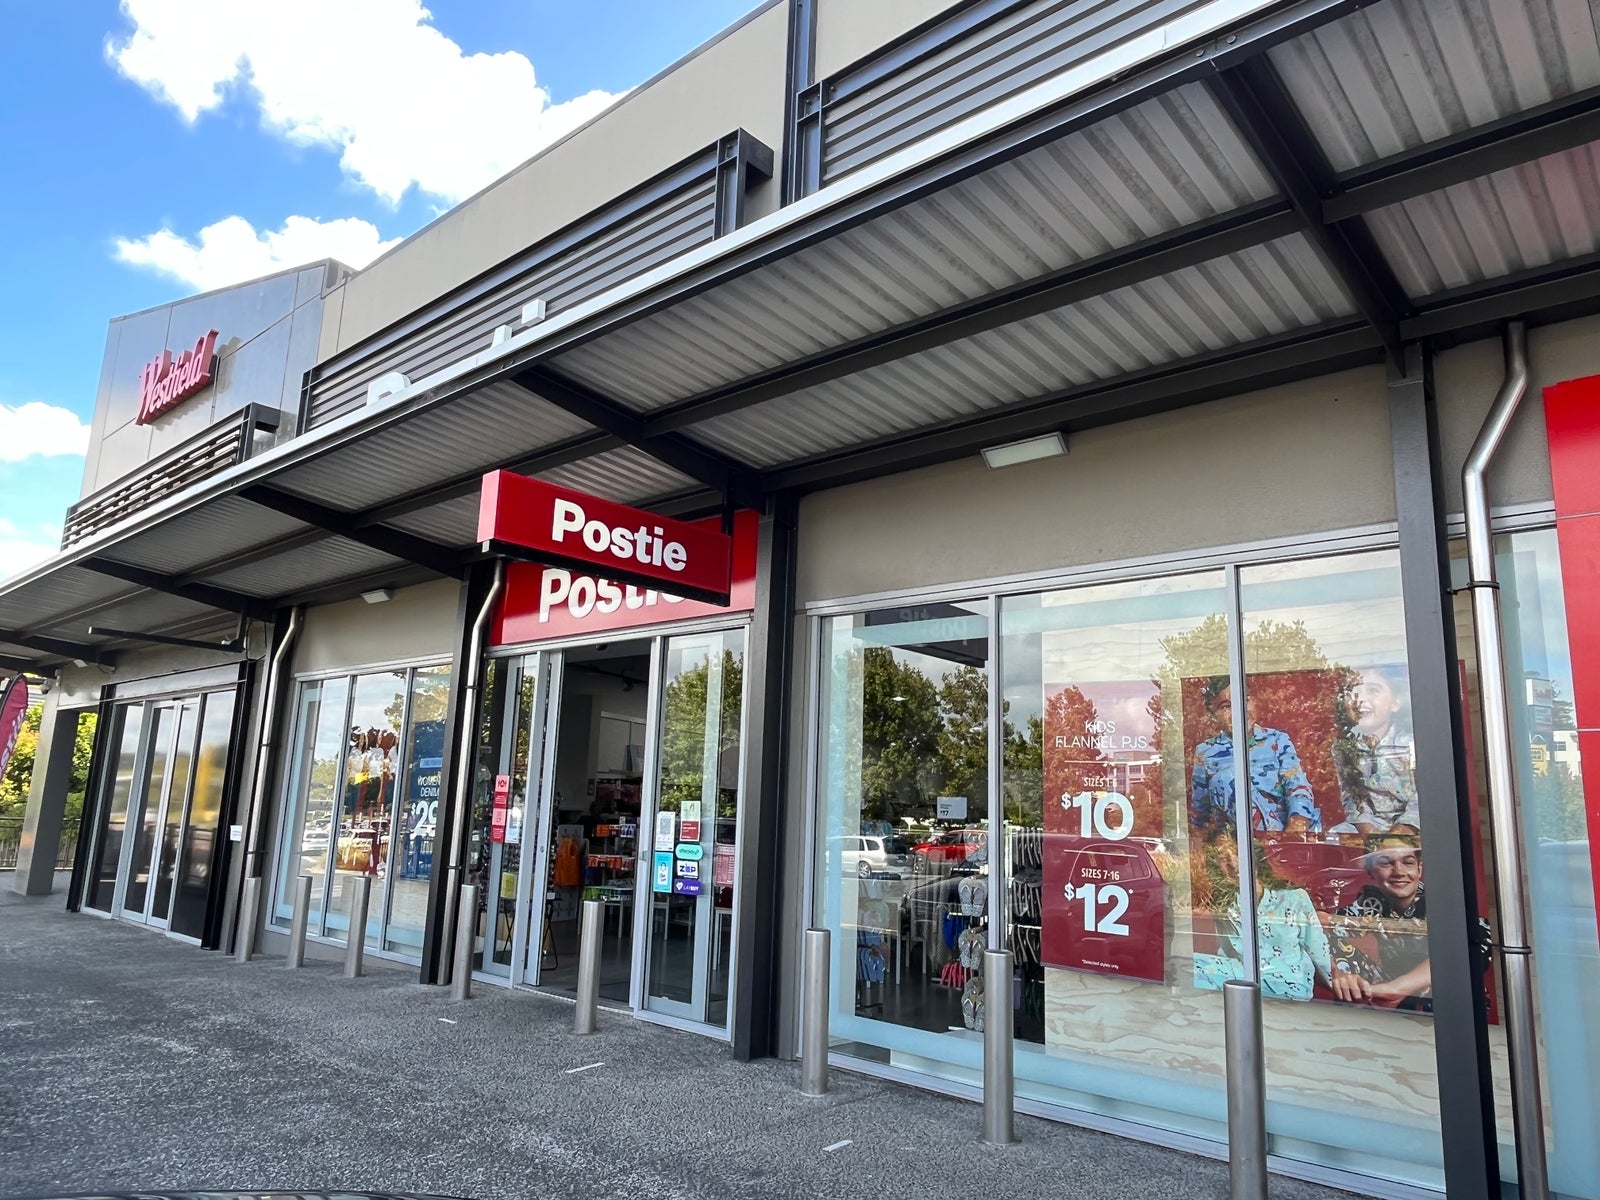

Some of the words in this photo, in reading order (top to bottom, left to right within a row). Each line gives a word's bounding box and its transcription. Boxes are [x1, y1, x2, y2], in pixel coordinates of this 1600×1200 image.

[135, 329, 219, 425] Westfield
[552, 498, 687, 571] Postie
[538, 568, 686, 623] Post
[1085, 720, 1116, 733] KIDS
[1055, 735, 1117, 749] FLANNEL
[1121, 735, 1147, 749] PJS
[1083, 777, 1104, 787] SIZES
[1081, 867, 1102, 879] SIZES
[1103, 868, 1120, 880] 7-16
